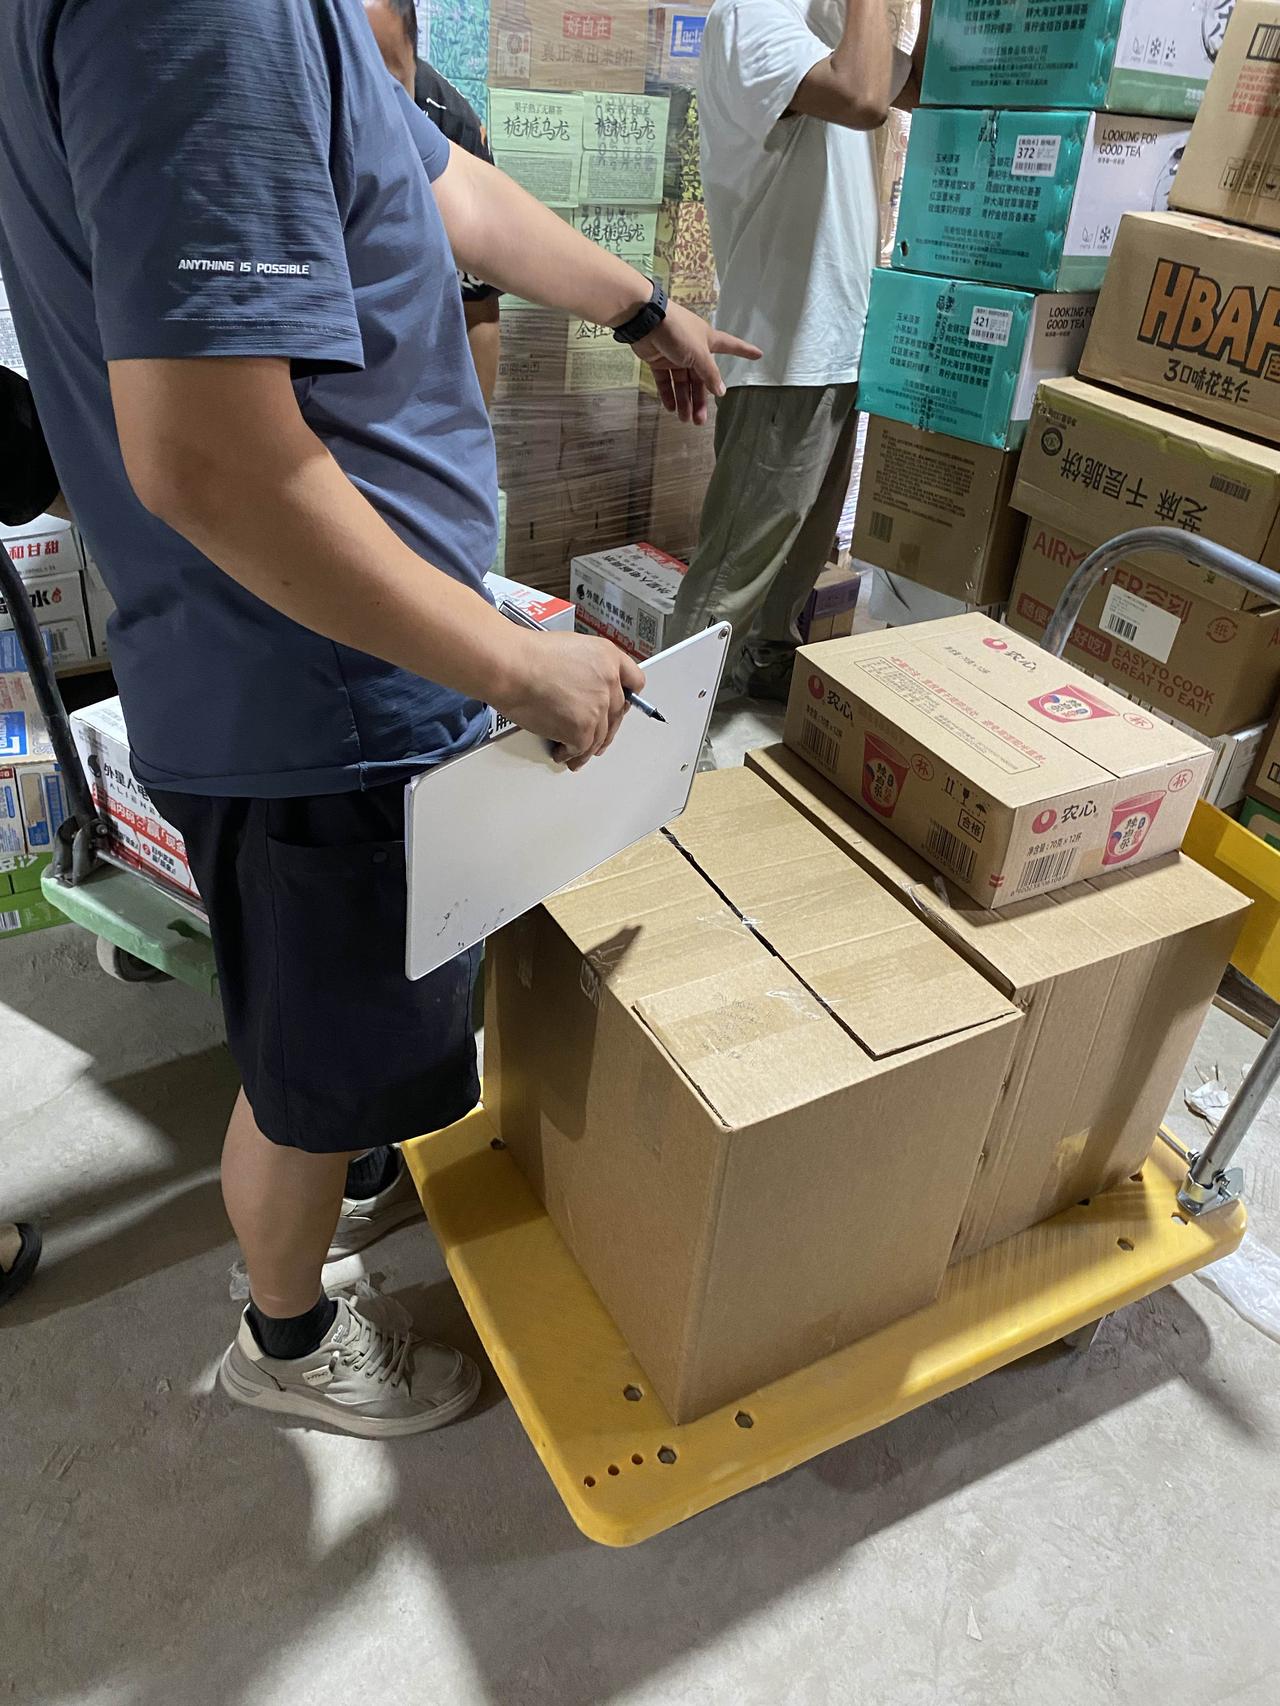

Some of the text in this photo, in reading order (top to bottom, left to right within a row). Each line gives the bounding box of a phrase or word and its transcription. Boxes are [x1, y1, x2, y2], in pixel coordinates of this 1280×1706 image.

[565, 14, 609, 37] 好自在
[1102, 129, 1158, 145] LOOKING FOR
[1016, 147, 1036, 159] 372
[1099, 143, 1142, 158] GOOD TEA
[178, 259, 310, 275] ANYTHING IS POSSIBLE
[973, 316, 990, 328] 421
[1049, 306, 1084, 318] LOOKING
[1046, 319, 1085, 330] GOOD TEA
[1163, 358, 1251, 404] 3口味花生仁
[1060, 447, 1208, 533] 芝麻 千层脆饼
[8, 540, 60, 560] 和甘甜
[1114, 644, 1217, 705] EASY TO COOK
[1111, 656, 1212, 717] GREAT TO EAT!
[827, 690, 853, 721] 农心
[1060, 800, 1098, 823] 农心
[961, 815, 982, 838] 合格
